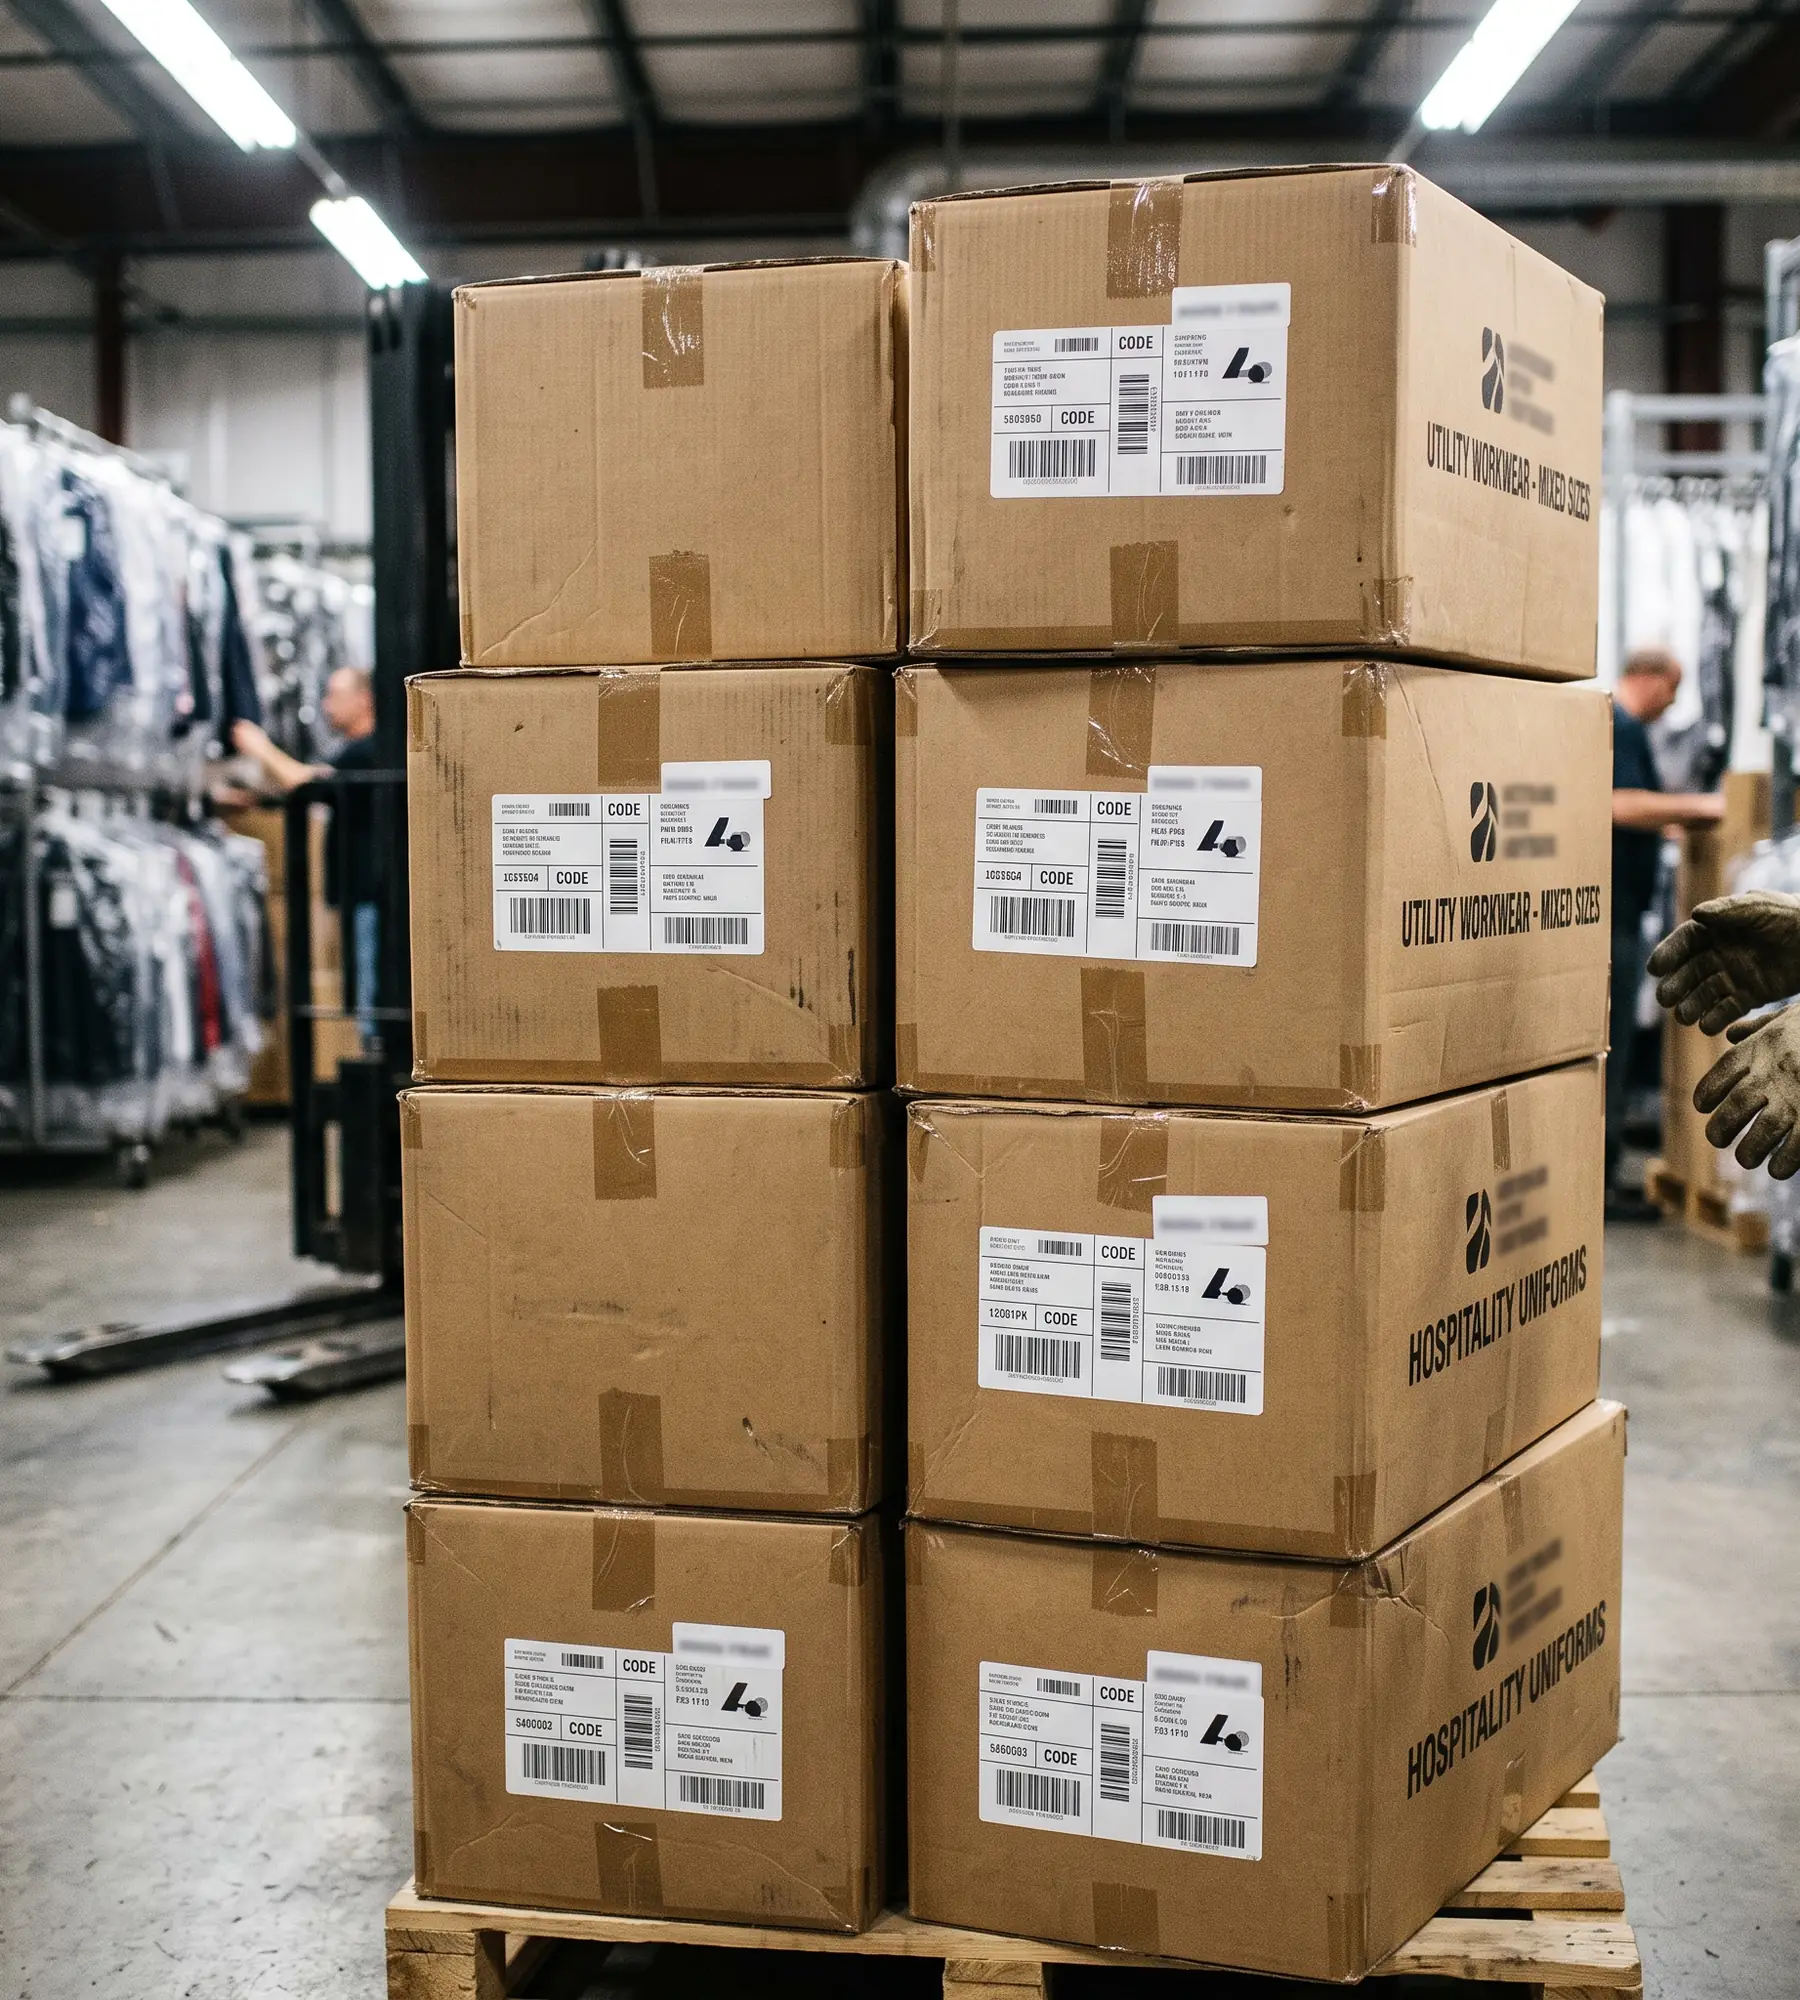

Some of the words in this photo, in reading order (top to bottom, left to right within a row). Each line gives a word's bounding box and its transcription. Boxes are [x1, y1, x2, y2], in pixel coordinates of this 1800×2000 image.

[1119, 336, 1153, 350] CODE
[1061, 411, 1094, 424] CODE
[1427, 421, 1470, 478] UTILITY
[1472, 438, 1530, 500] WORKWEAR
[1538, 464, 1565, 512] MIXED
[1567, 476, 1591, 521] SIZES
[609, 803, 640, 816] CODE
[1097, 801, 1131, 815] CODE
[557, 872, 588, 884] CODE
[1041, 871, 1073, 885] CODE
[1402, 897, 1457, 947] UTILITY
[1460, 891, 1530, 941] WORKWEAR
[1541, 888, 1572, 930] MIXED
[1575, 885, 1600, 926] SIZES
[1102, 1245, 1135, 1260] CODE
[1045, 1312, 1077, 1326] CODE
[1409, 1283, 1515, 1387] HOSPITALITY
[1519, 1244, 1587, 1326] UNIFORMS
[623, 1659, 656, 1673] CODE
[1101, 1687, 1134, 1702] CODE
[1407, 1664, 1526, 1800] HOSPITALITY
[1530, 1600, 1606, 1703] UNIFORMS
[570, 1722, 602, 1736] CODE
[1045, 1750, 1077, 1765] CODE
